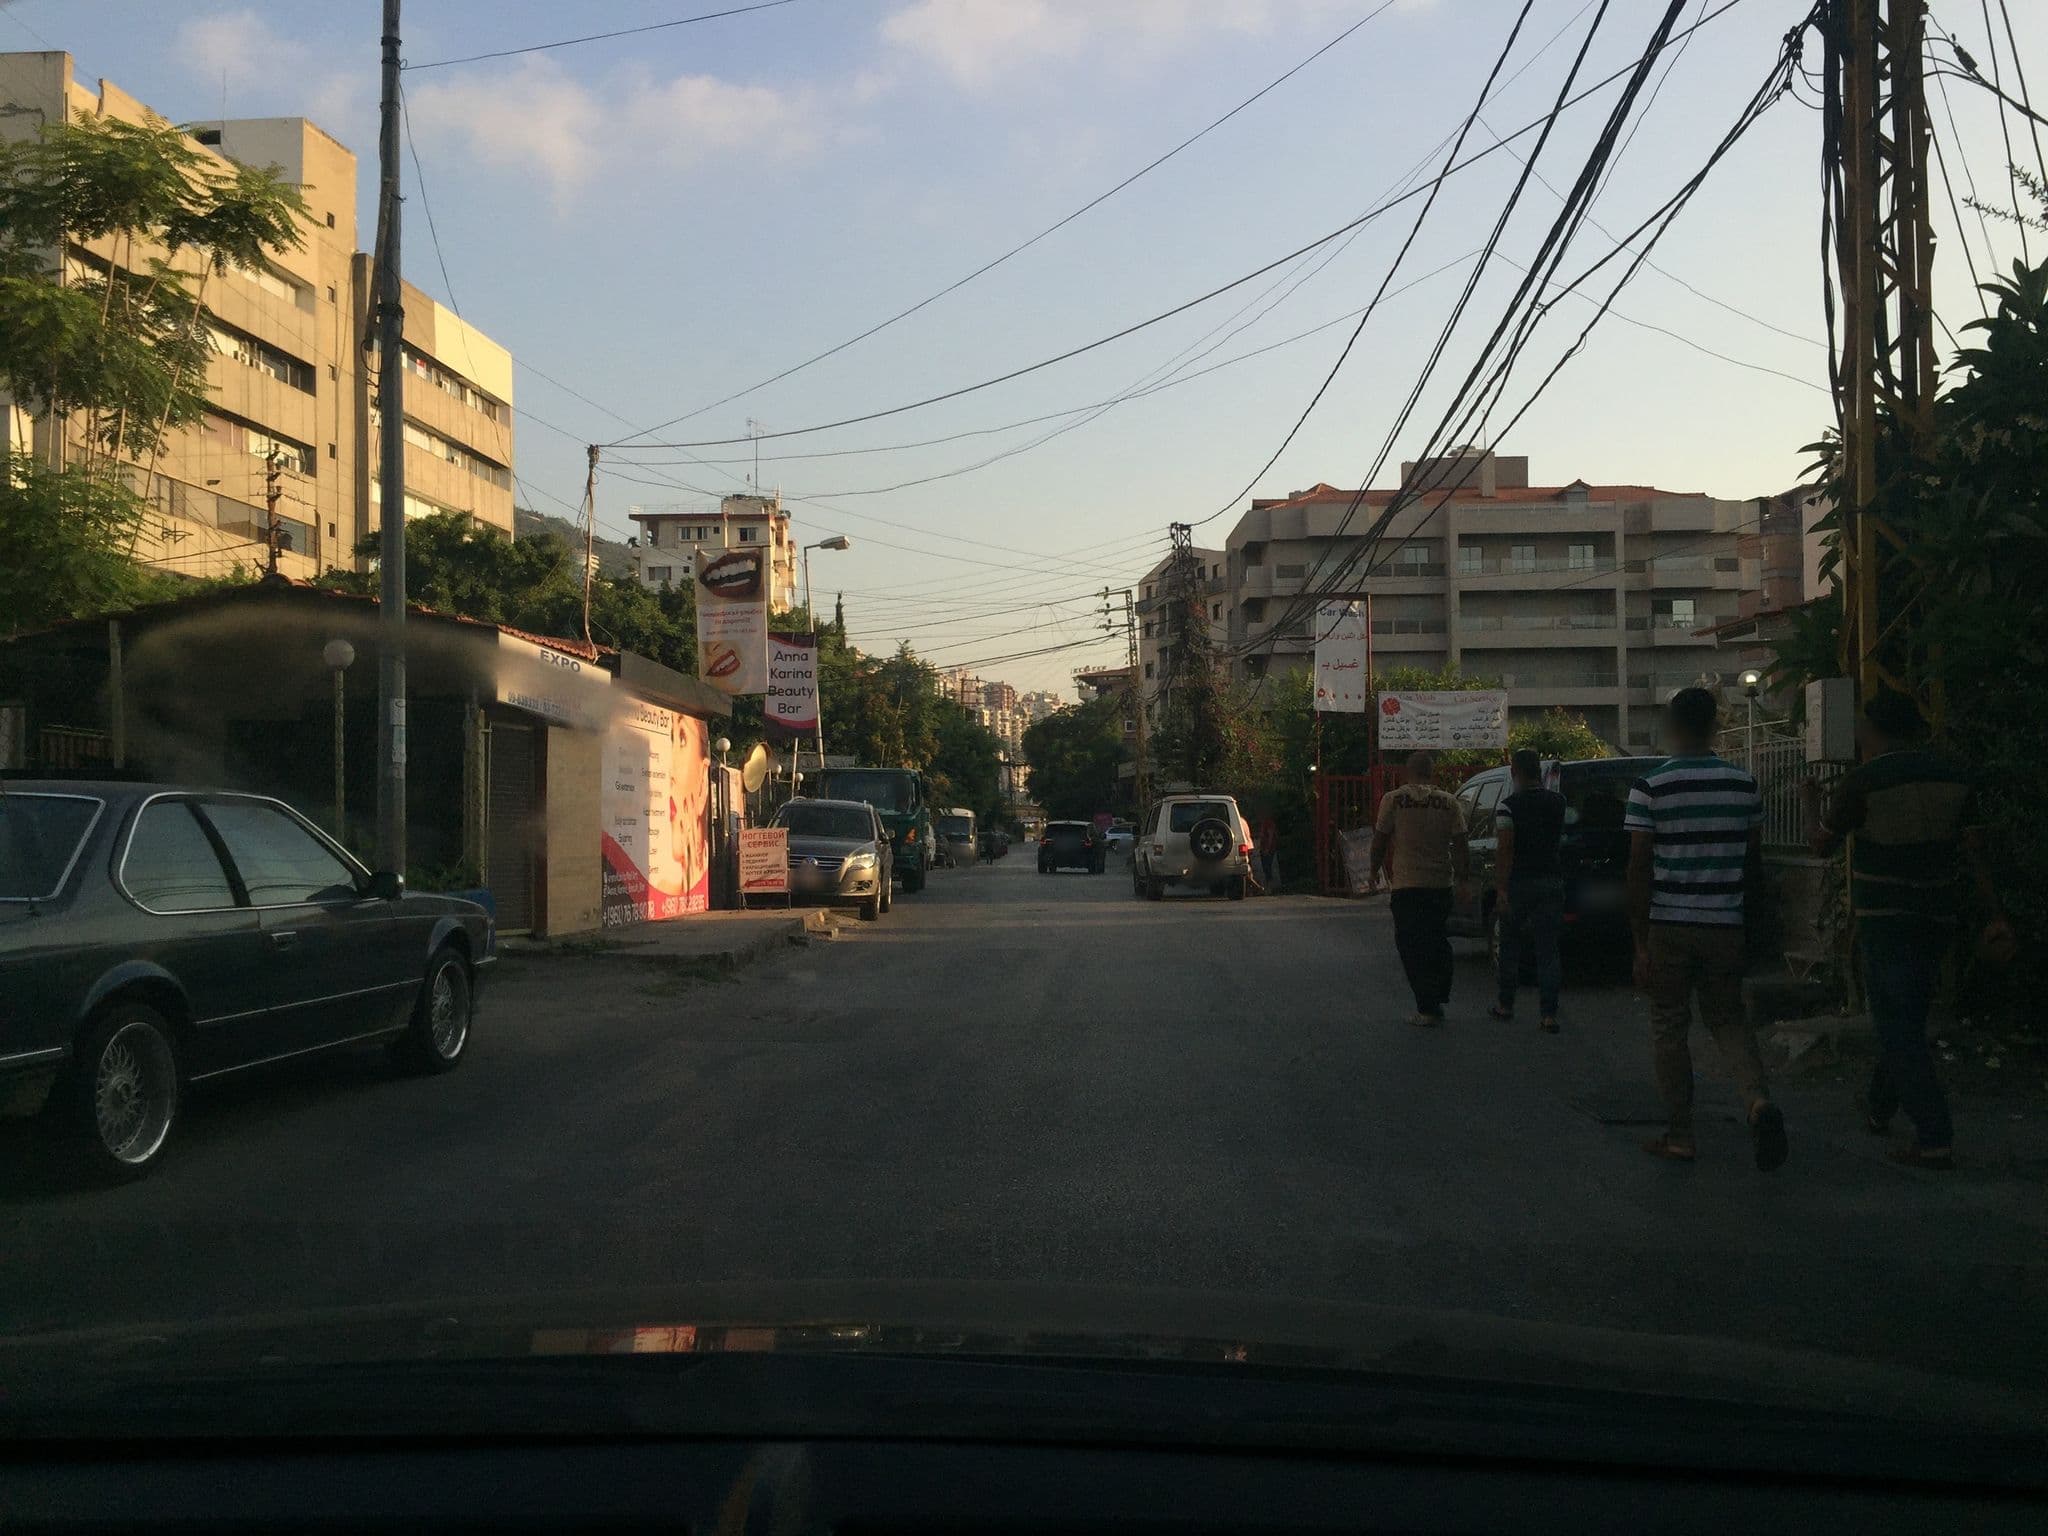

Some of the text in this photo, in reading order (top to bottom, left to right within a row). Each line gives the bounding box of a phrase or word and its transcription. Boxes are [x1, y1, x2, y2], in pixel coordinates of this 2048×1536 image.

[1319, 608, 1337, 616] Car
[540, 649, 581, 672] EXPO
[774, 651, 808, 662] Anna
[1333, 658, 1360, 671] غسيل
[770, 668, 812, 679] Karina
[768, 685, 814, 699] Beauty
[777, 703, 802, 714] Bar
[660, 710, 670, 728] Bar
[742, 830, 784, 840] НОГТЕВОЙ
[748, 840, 779, 848] СЕРВИС
